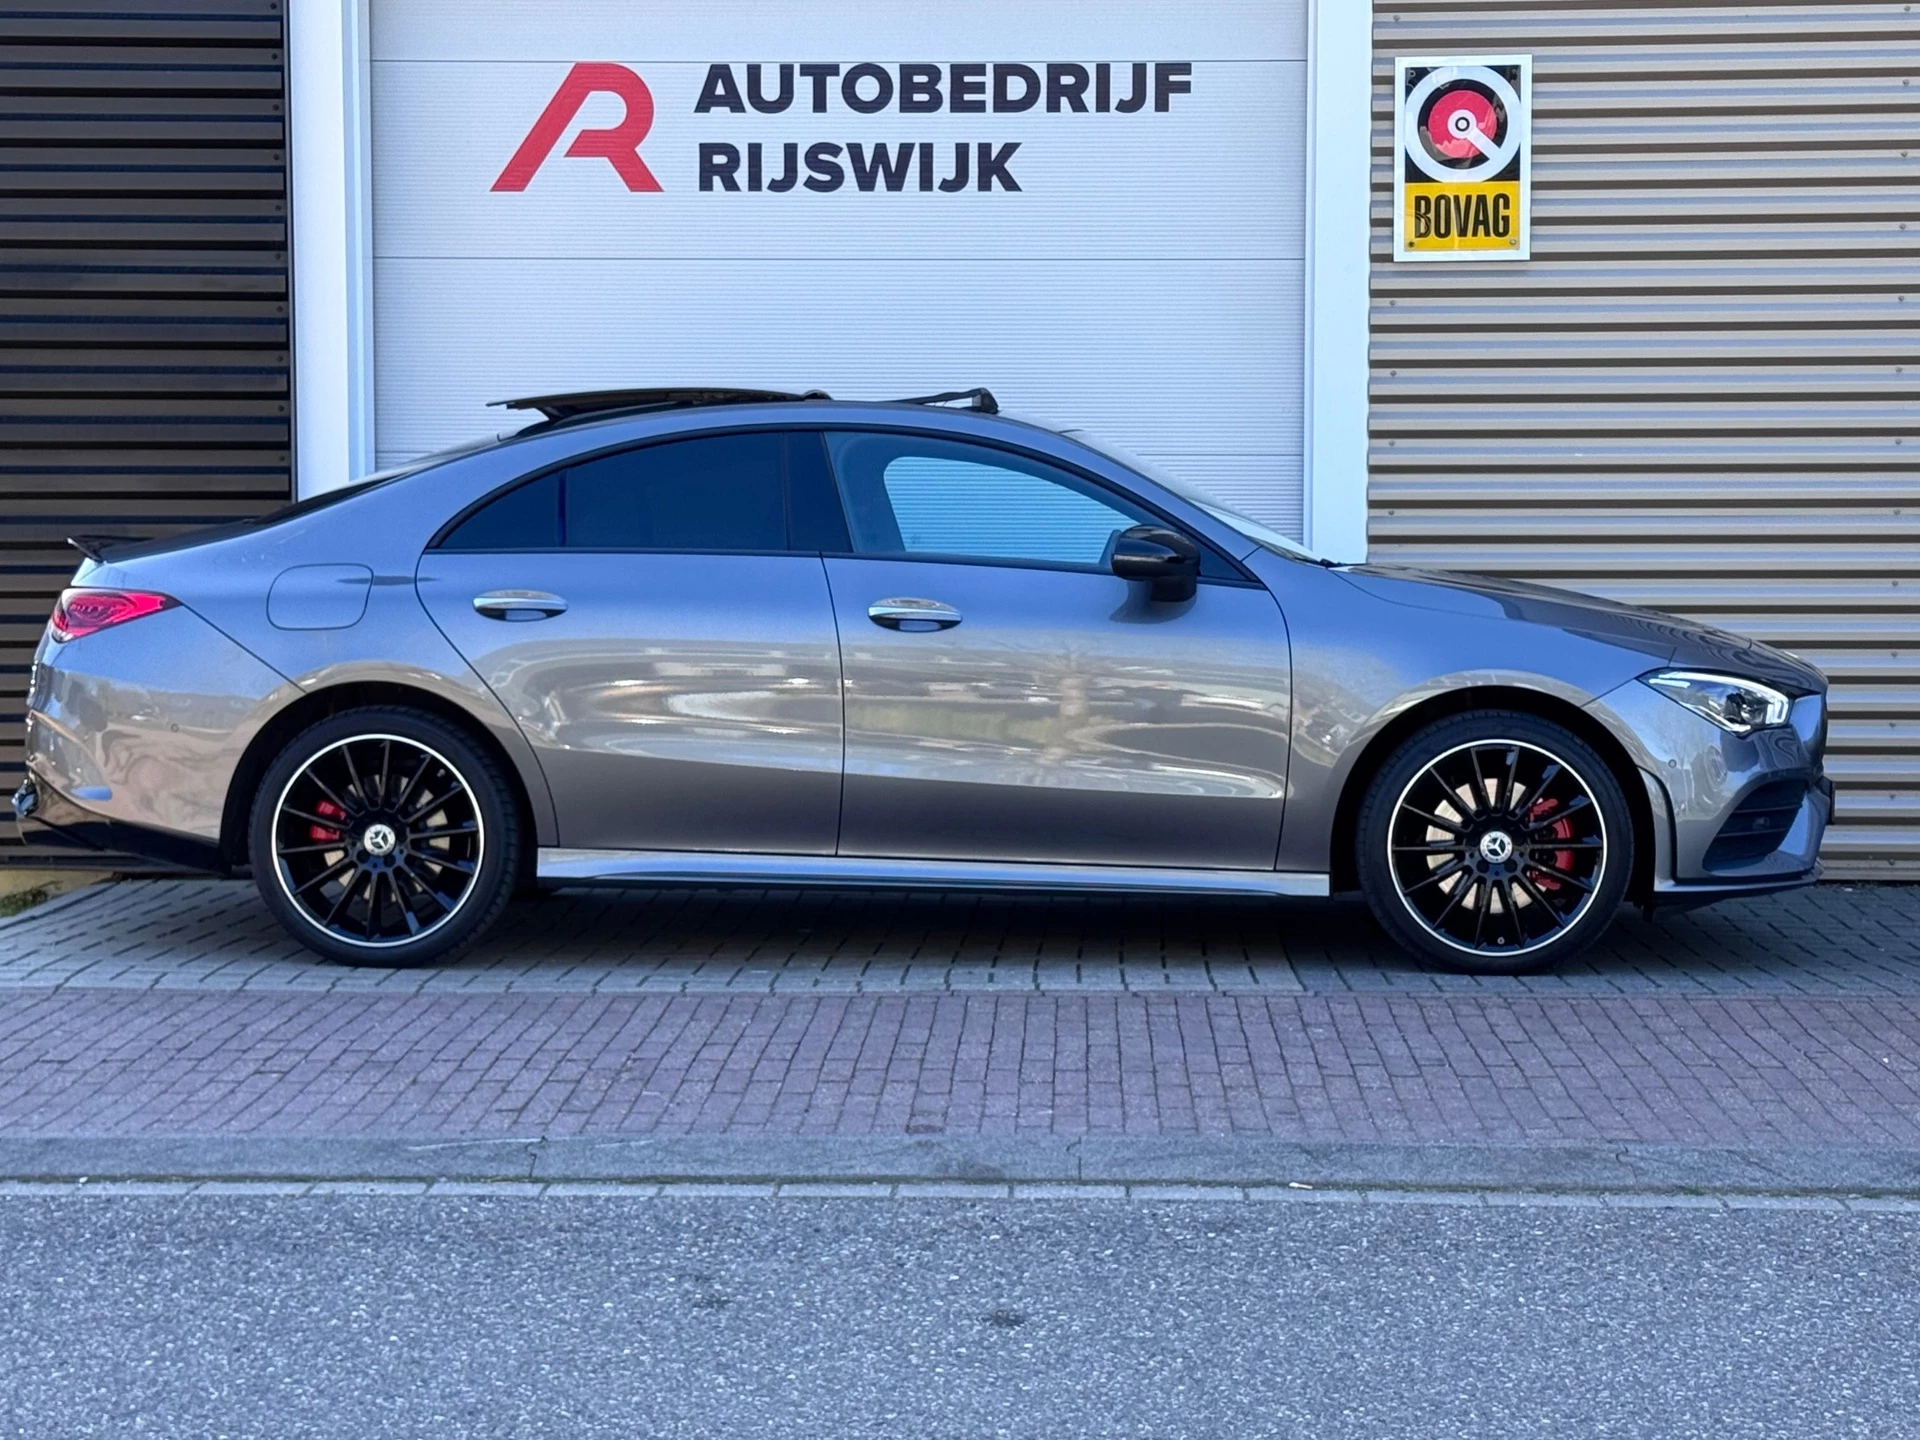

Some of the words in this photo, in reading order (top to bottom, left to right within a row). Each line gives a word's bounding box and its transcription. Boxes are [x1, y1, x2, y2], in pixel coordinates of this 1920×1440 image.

[693, 63, 1192, 114] AUTOBEDRIJF
[698, 142, 1022, 193] RIJSWIJK
[1414, 192, 1511, 239] BOVAG
